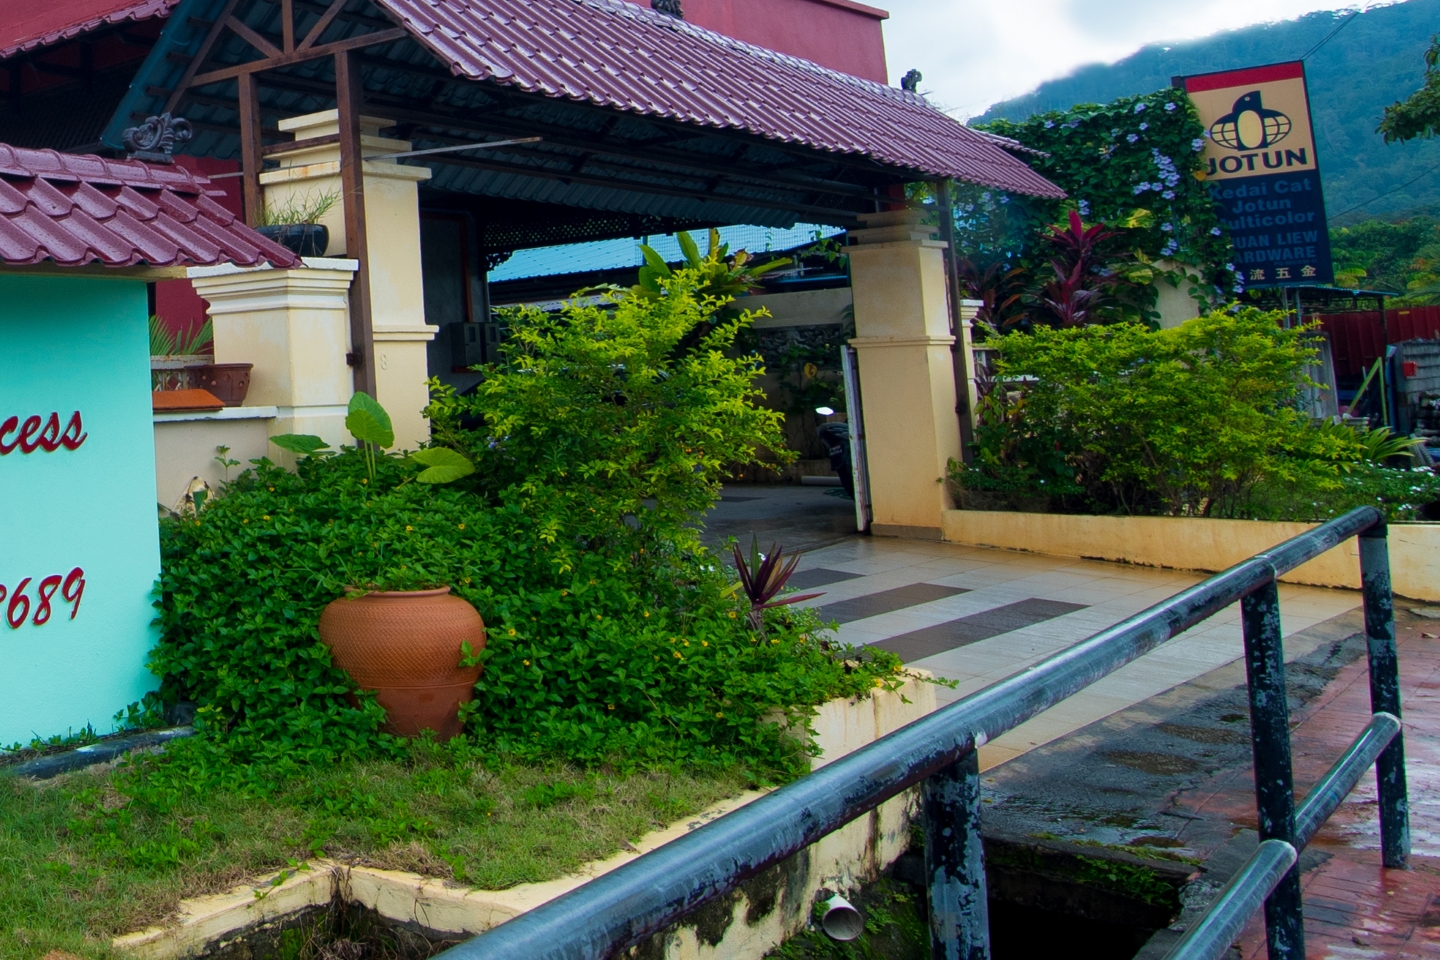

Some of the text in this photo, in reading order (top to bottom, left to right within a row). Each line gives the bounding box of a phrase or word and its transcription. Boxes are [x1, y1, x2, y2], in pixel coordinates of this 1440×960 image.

[1206, 148, 1308, 176] JOTUN
[1209, 178, 1312, 200] Kedai Cat
[1232, 198, 1292, 214] Jotun
[1277, 230, 1318, 245] LIEW
[1233, 245, 1316, 264] ARDWARE
